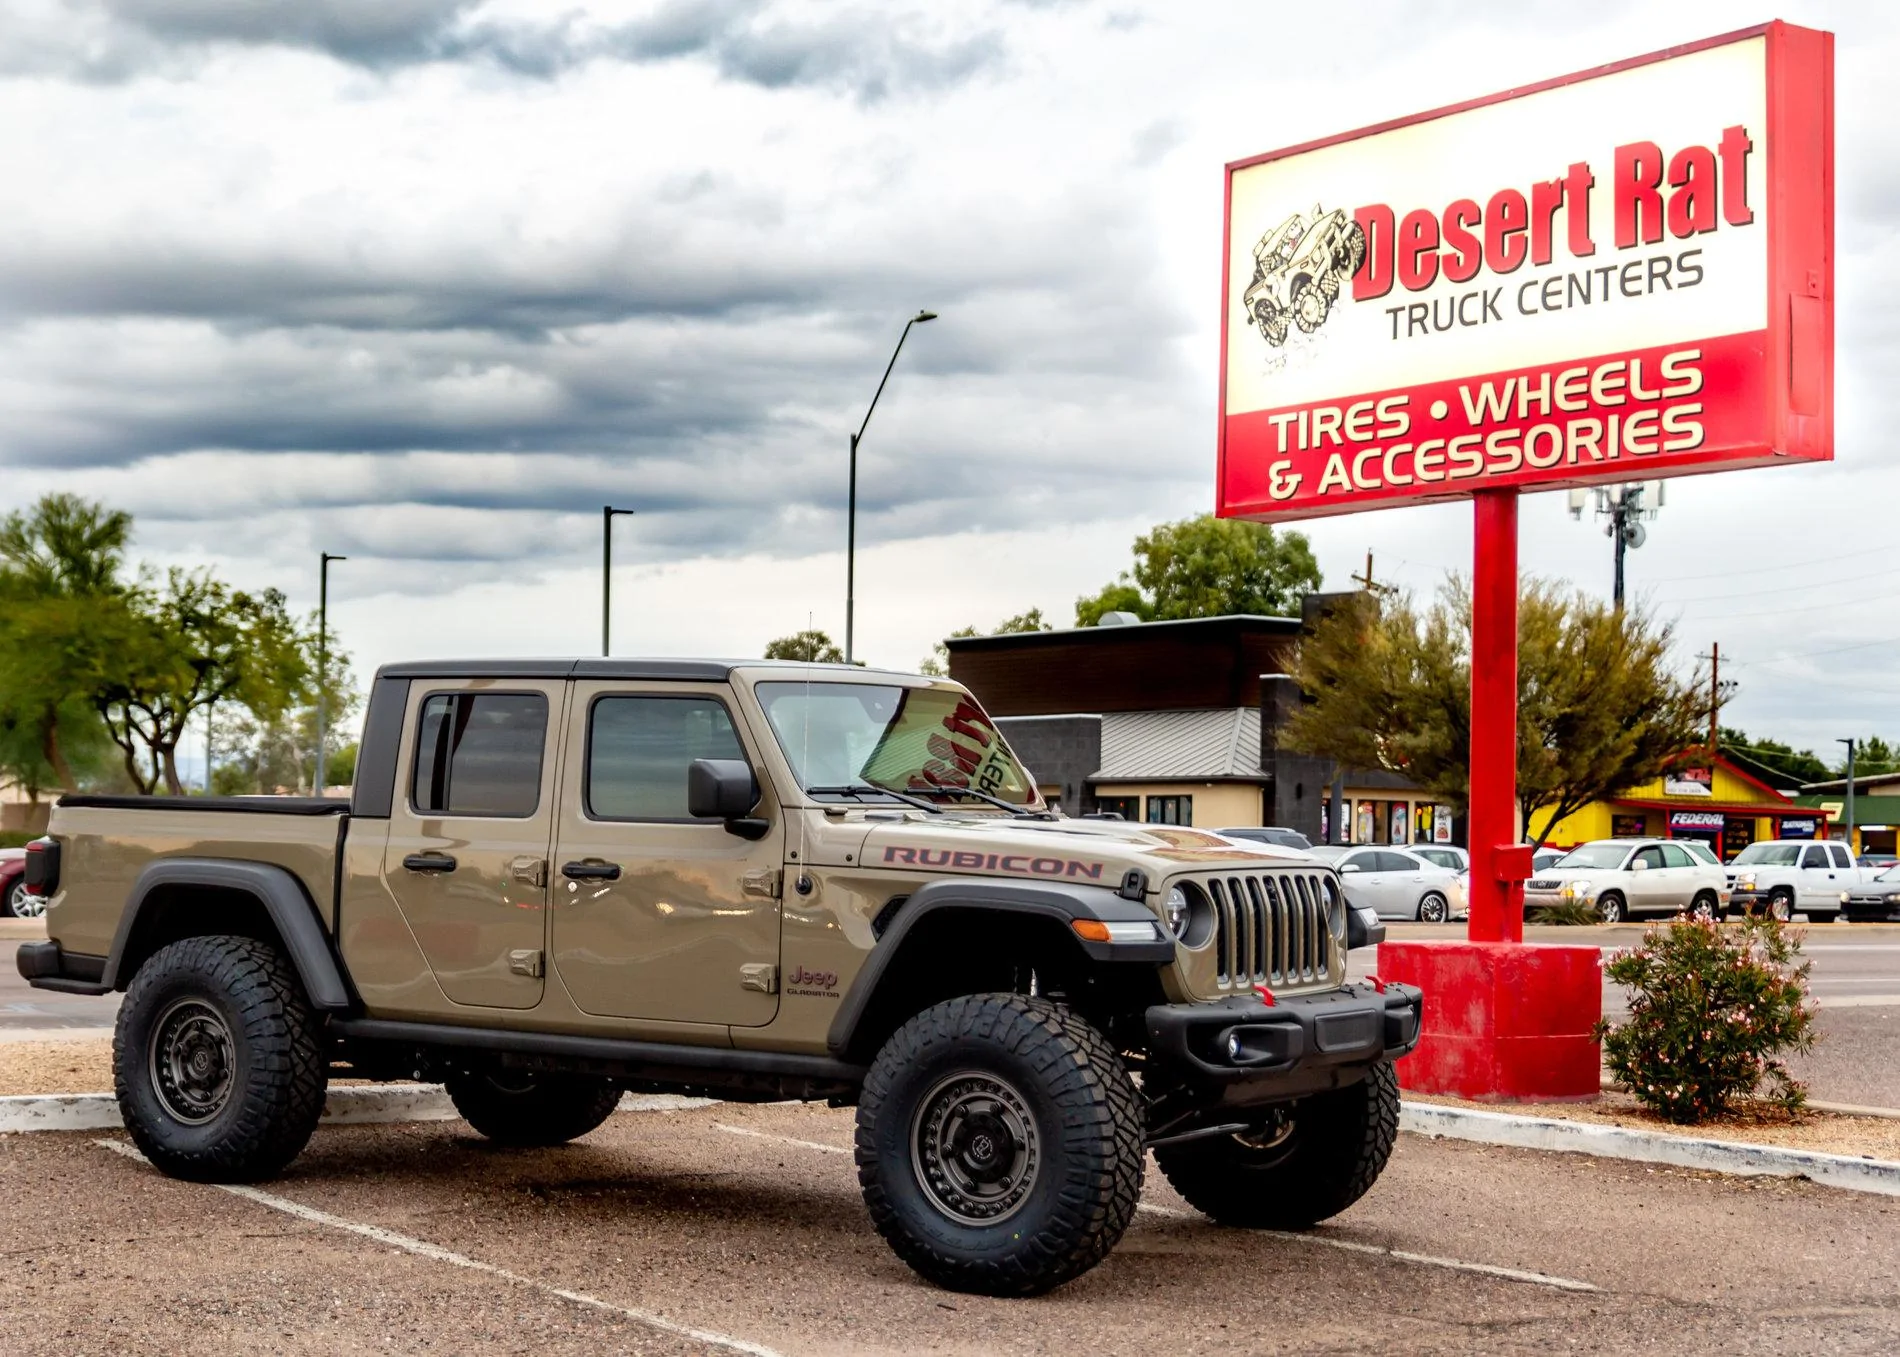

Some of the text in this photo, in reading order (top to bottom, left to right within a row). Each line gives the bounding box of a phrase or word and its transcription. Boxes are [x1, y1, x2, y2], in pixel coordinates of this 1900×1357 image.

[1352, 124, 1754, 302] Desert Rat
[1386, 248, 1704, 340] TRUCK CENTERS
[1268, 349, 1704, 453] TIRES WHEELS
[1268, 403, 1705, 501] & ACCESSORIES
[1671, 813, 1725, 825] FEDERAL
[883, 846, 1104, 879] RUBICON
[787, 988, 840, 998] GLADIATOR
[789, 965, 839, 990] Jeep
